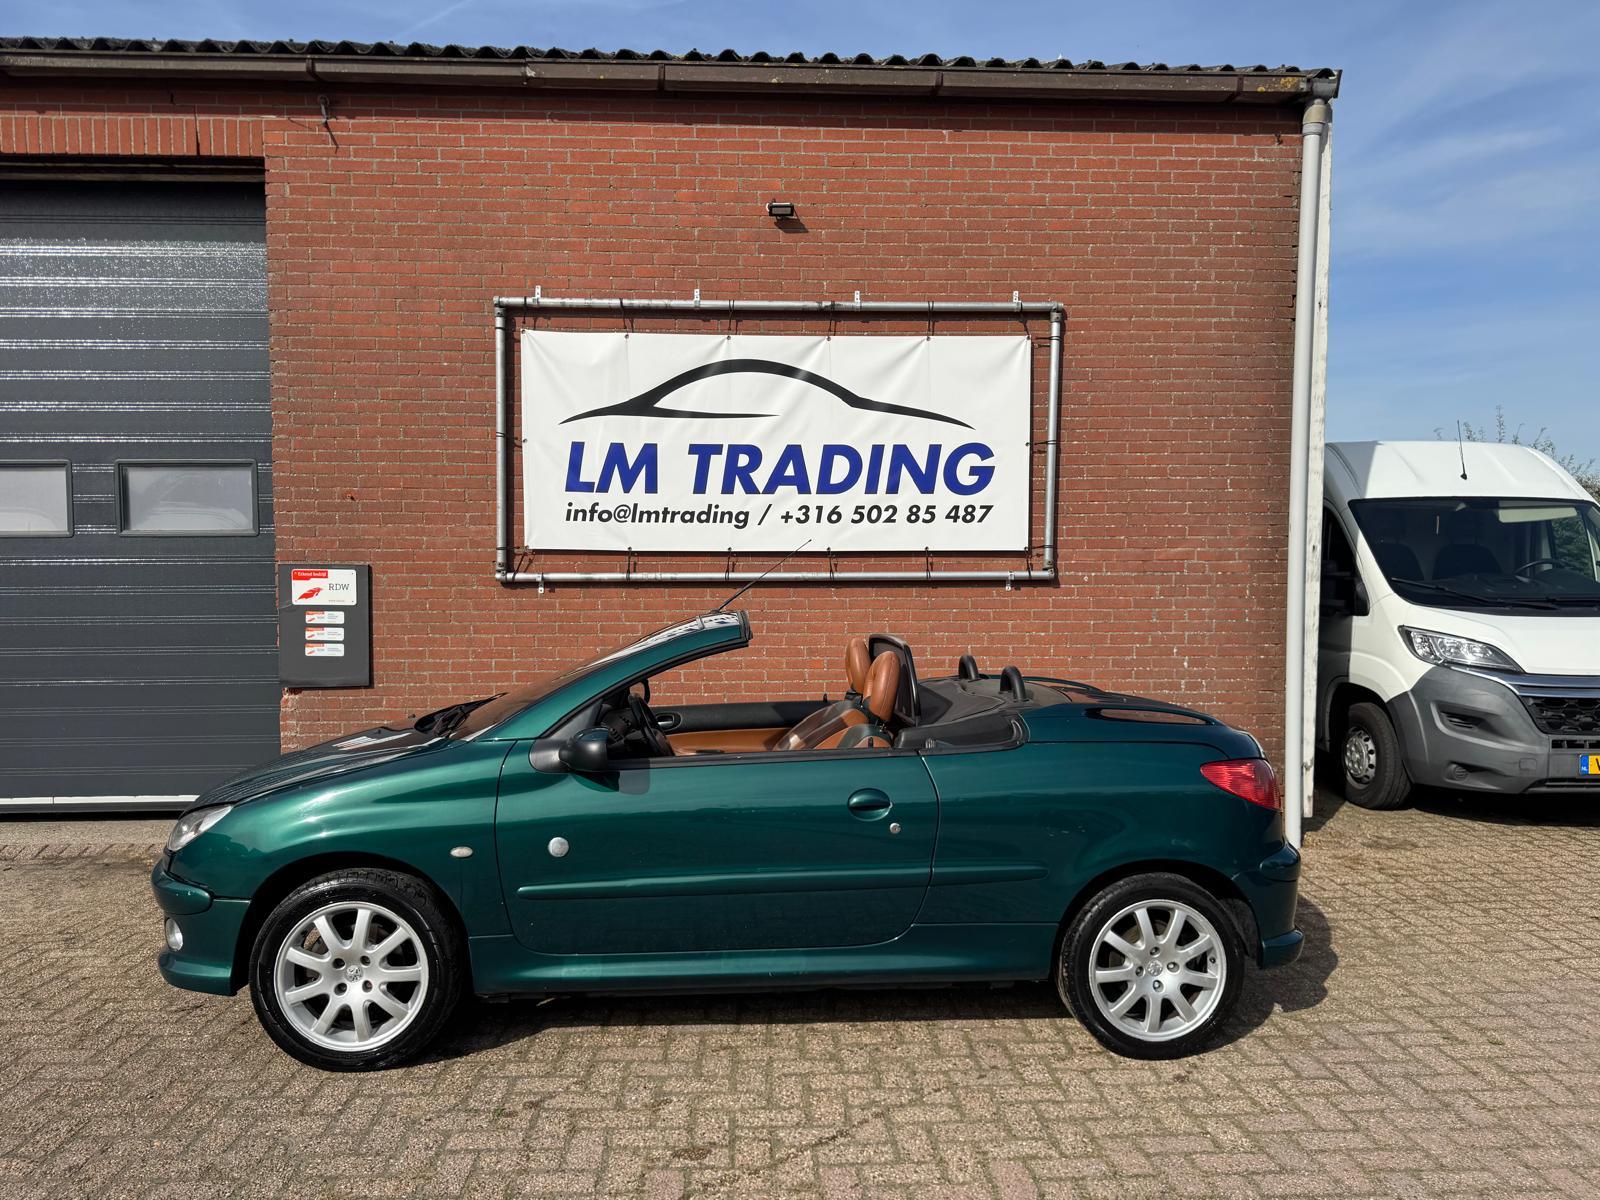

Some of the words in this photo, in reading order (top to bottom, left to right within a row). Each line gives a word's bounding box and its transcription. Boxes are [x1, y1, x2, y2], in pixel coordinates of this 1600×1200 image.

[565, 442, 658, 494] LM
[688, 443, 995, 495] TRADING
[566, 502, 749, 529] info@lmtrading
[758, 504, 772, 526] /
[781, 505, 842, 525] +316
[851, 505, 897, 524] 502
[907, 505, 936, 524] 85
[945, 505, 993, 524] 487
[328, 583, 350, 591] RDW
